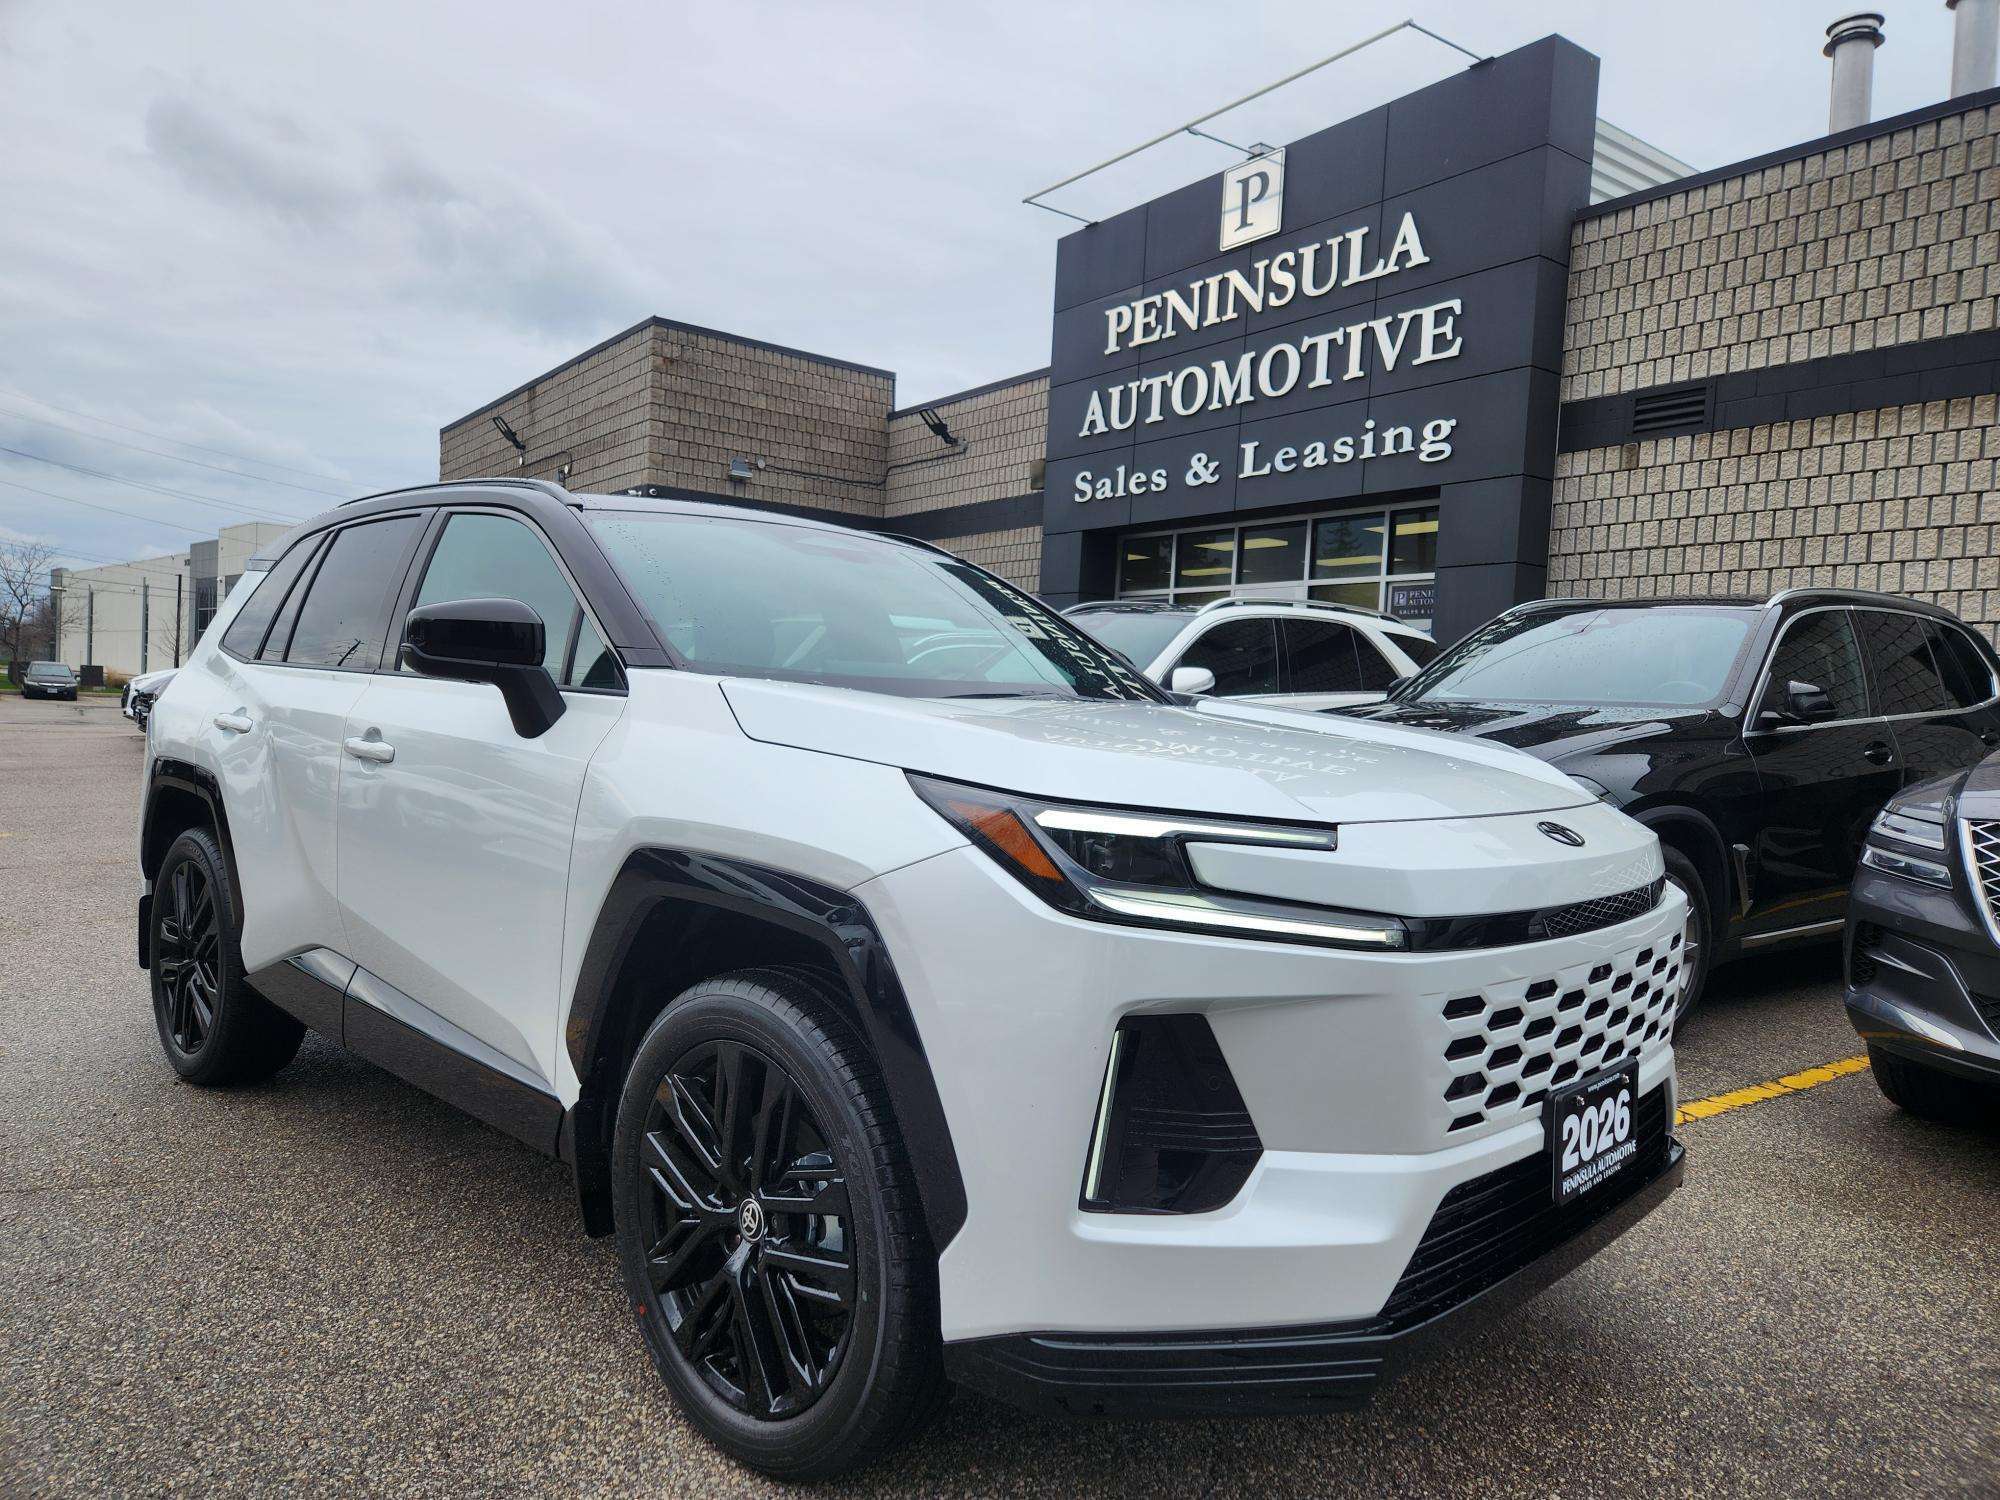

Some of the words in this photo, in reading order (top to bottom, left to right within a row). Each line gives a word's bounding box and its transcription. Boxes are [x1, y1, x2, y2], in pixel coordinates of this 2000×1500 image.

[1234, 170, 1270, 233] P
[1104, 212, 1430, 355] PENINSULA
[1078, 299, 1463, 438] AUTOMOTIVE
[1075, 465, 1167, 503] Sales
[1185, 454, 1219, 487] &
[1239, 419, 1456, 479] Leasing
[1409, 590, 1434, 598] PENI
[1562, 1089, 1630, 1172] 2026
[1562, 1164, 1597, 1196] PENINSULA
[1597, 1140, 1637, 1173] AUTOMOTIVE
[1579, 1181, 1593, 1195] SALES
[1593, 1175, 1602, 1185] AND
[1603, 1163, 1622, 1178] LEASING
